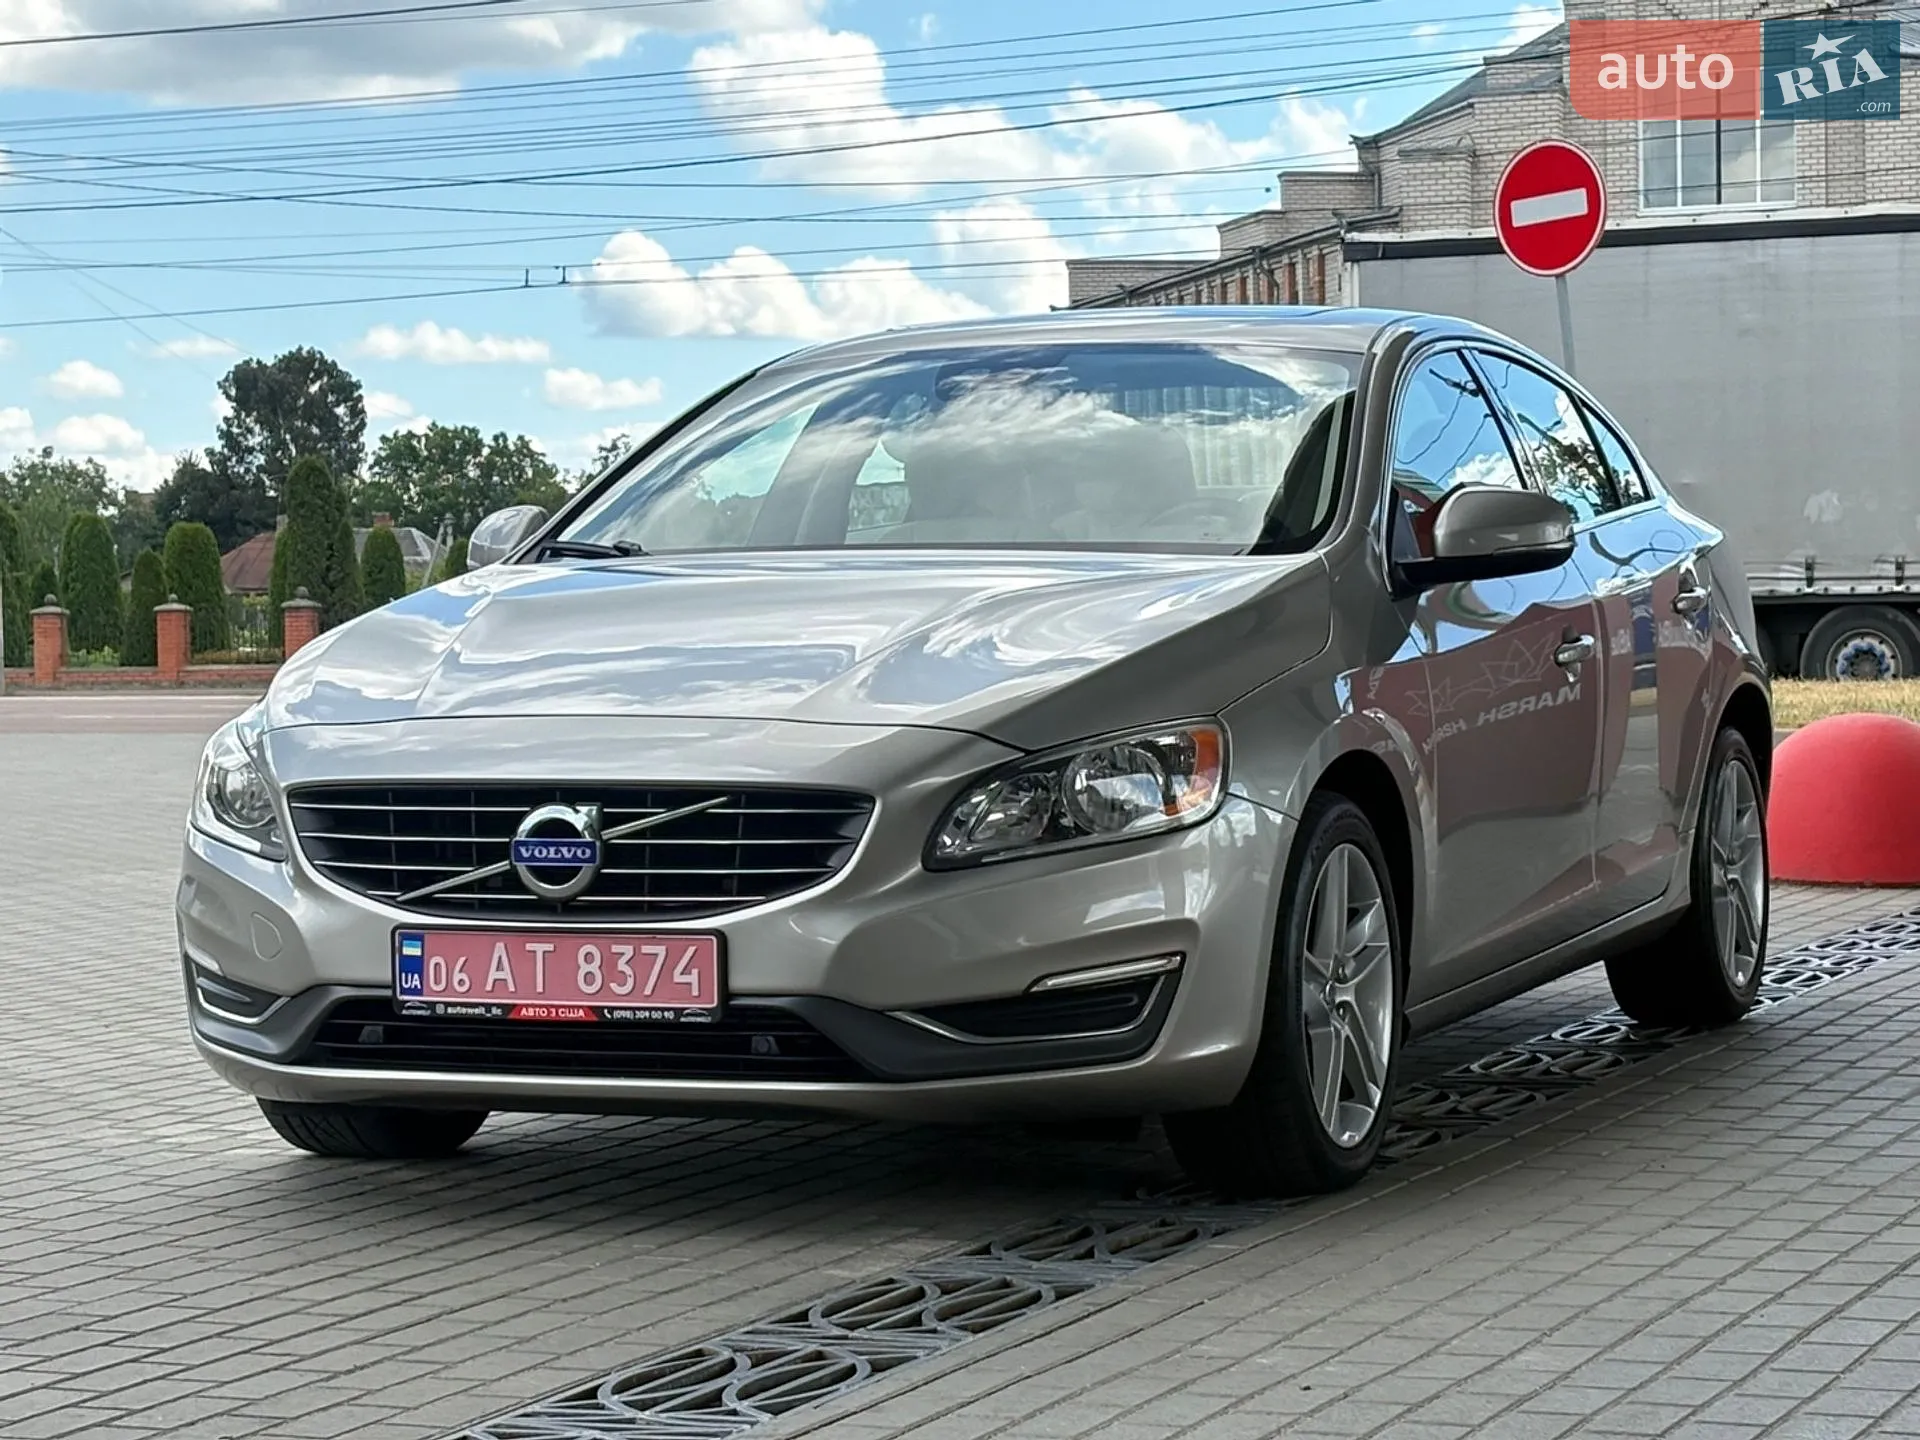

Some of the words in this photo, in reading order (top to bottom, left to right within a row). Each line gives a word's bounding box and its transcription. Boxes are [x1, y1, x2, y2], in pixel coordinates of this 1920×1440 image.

[519, 846, 591, 859] VOLVO
[428, 955, 472, 994] 06
[484, 942, 555, 994] AT
[576, 944, 701, 997] 8374
[402, 972, 422, 989] UA
[520, 1007, 547, 1018] АВТО
[558, 1008, 585, 1019] США
